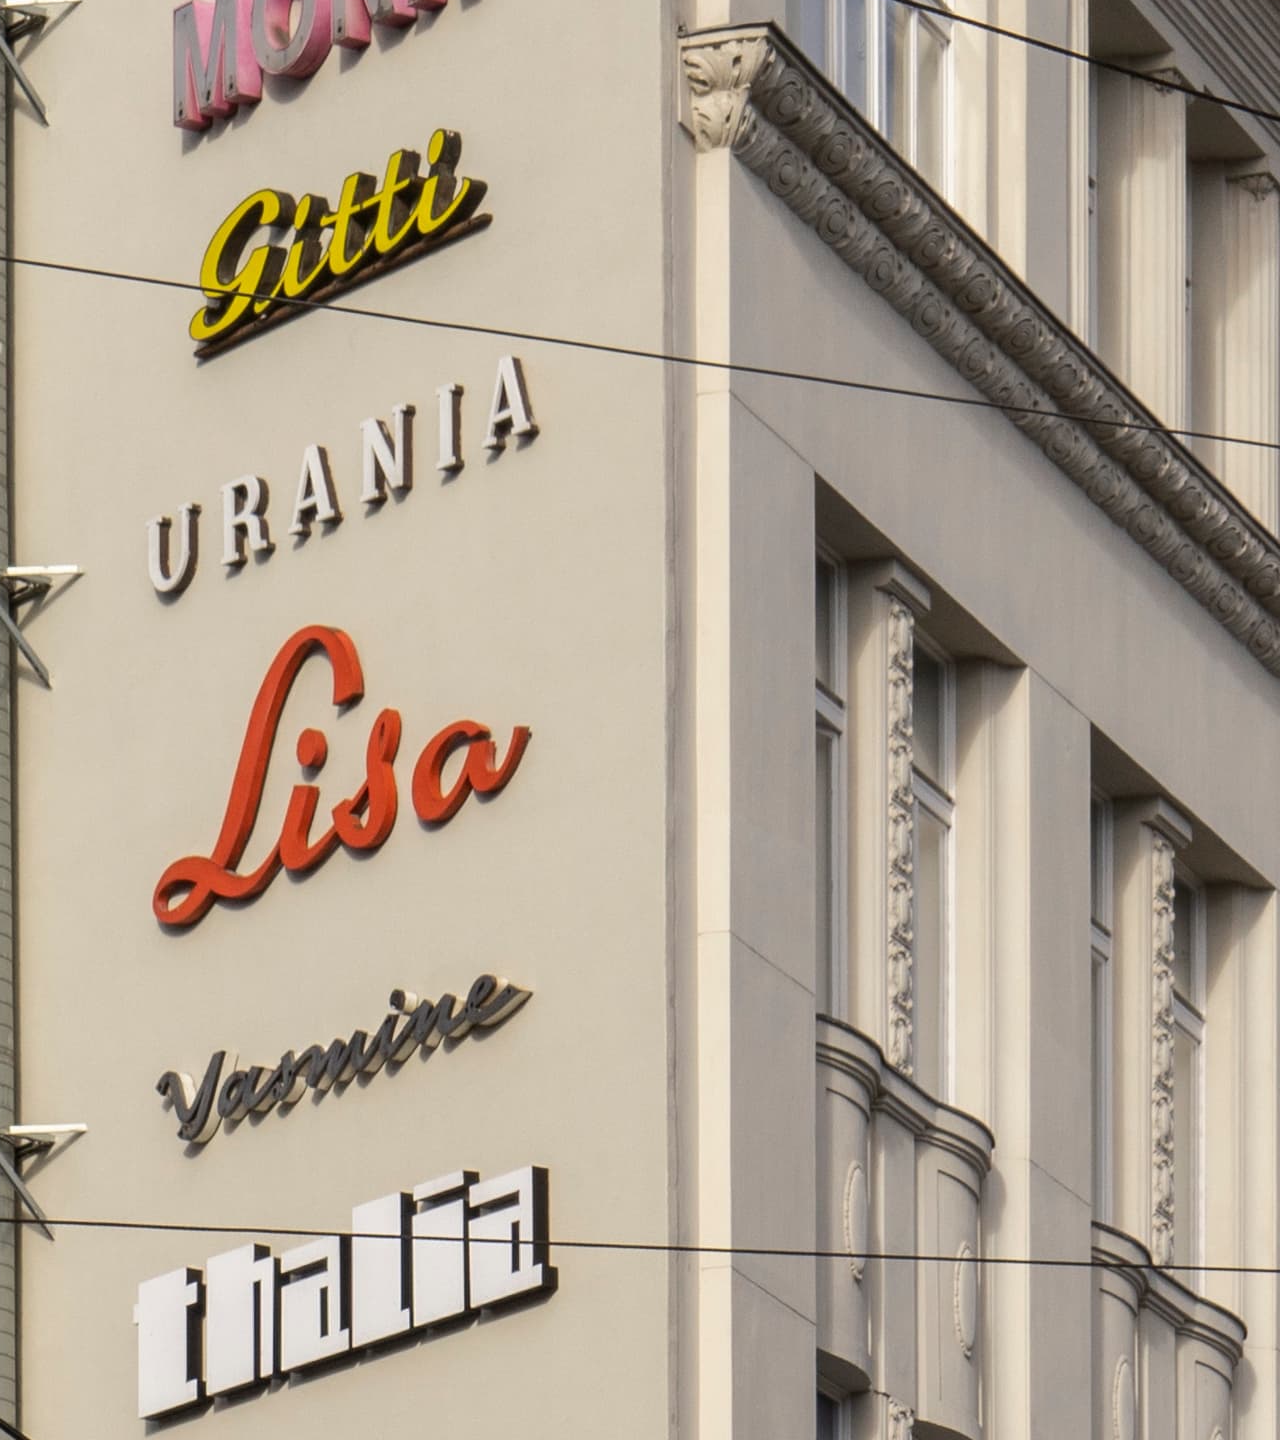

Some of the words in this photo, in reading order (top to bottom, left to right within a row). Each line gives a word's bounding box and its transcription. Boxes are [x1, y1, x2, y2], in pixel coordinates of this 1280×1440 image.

[188, 128, 488, 343] Gitti
[146, 356, 539, 594] URANIA
[153, 625, 530, 926] Lisa
[155, 973, 534, 1144] Yasmine
